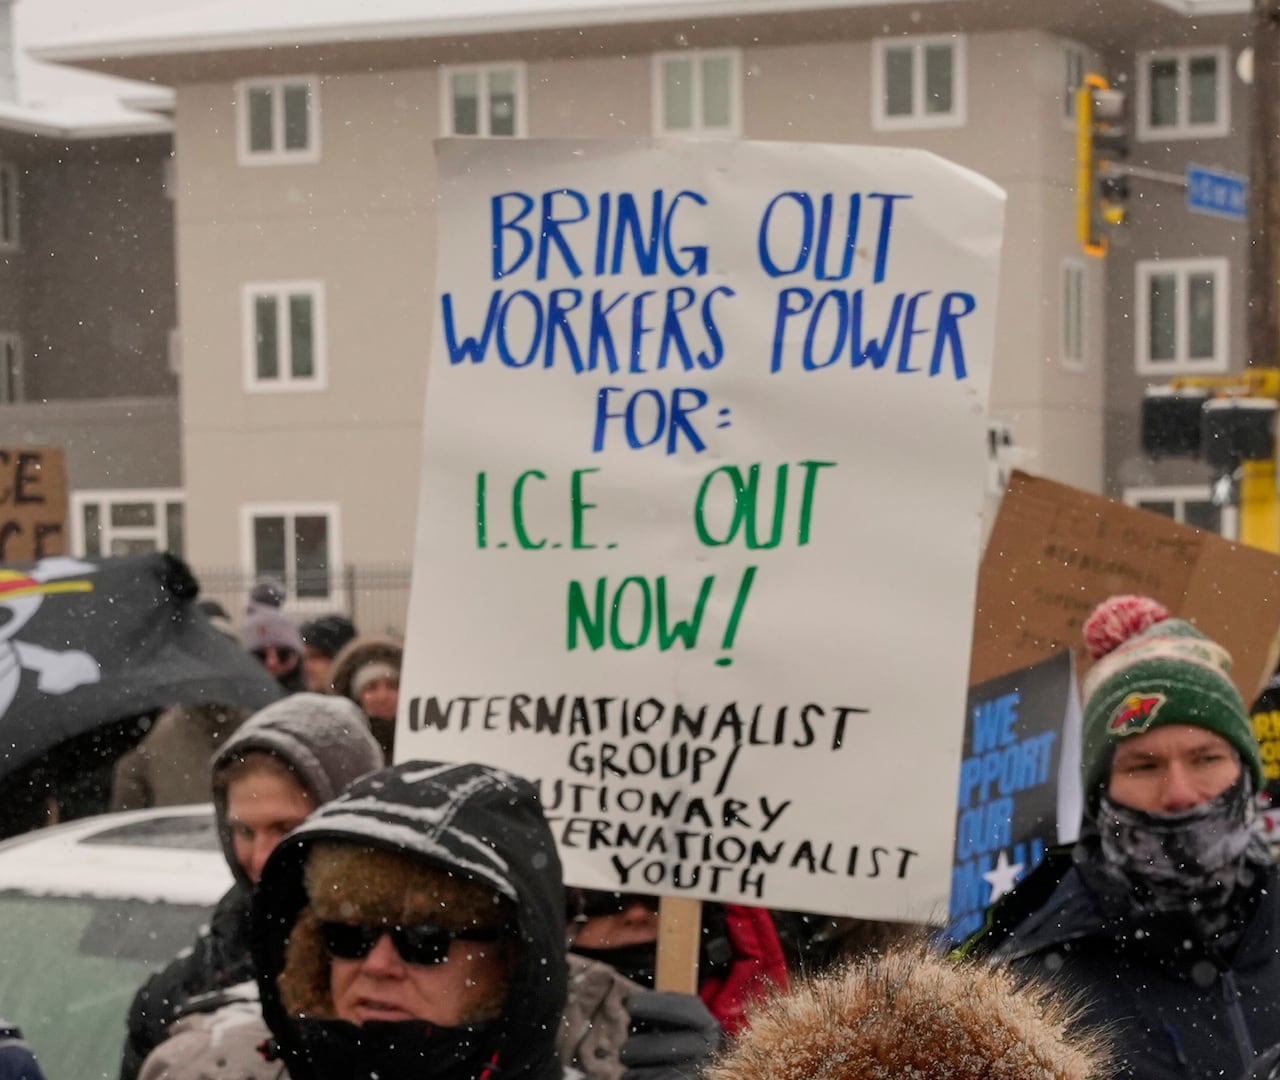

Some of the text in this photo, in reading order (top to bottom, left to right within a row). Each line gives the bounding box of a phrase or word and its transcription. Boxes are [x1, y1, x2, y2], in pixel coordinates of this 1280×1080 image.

[490, 189, 914, 283] BRING OUT
[441, 286, 977, 379] WORKERS POWER
[591, 386, 733, 455] FOR:
[476, 460, 838, 550] I.C.E. OUT
[566, 566, 758, 667] NOW!
[408, 693, 871, 751] INTERNATIONALIST
[973, 692, 1021, 753] WE
[567, 740, 743, 796] GROUP/
[958, 730, 1058, 808] PPORT
[538, 777, 793, 832] UTIONARY
[548, 816, 920, 880] ERNATIONALIST
[610, 853, 767, 898] YOUTH
